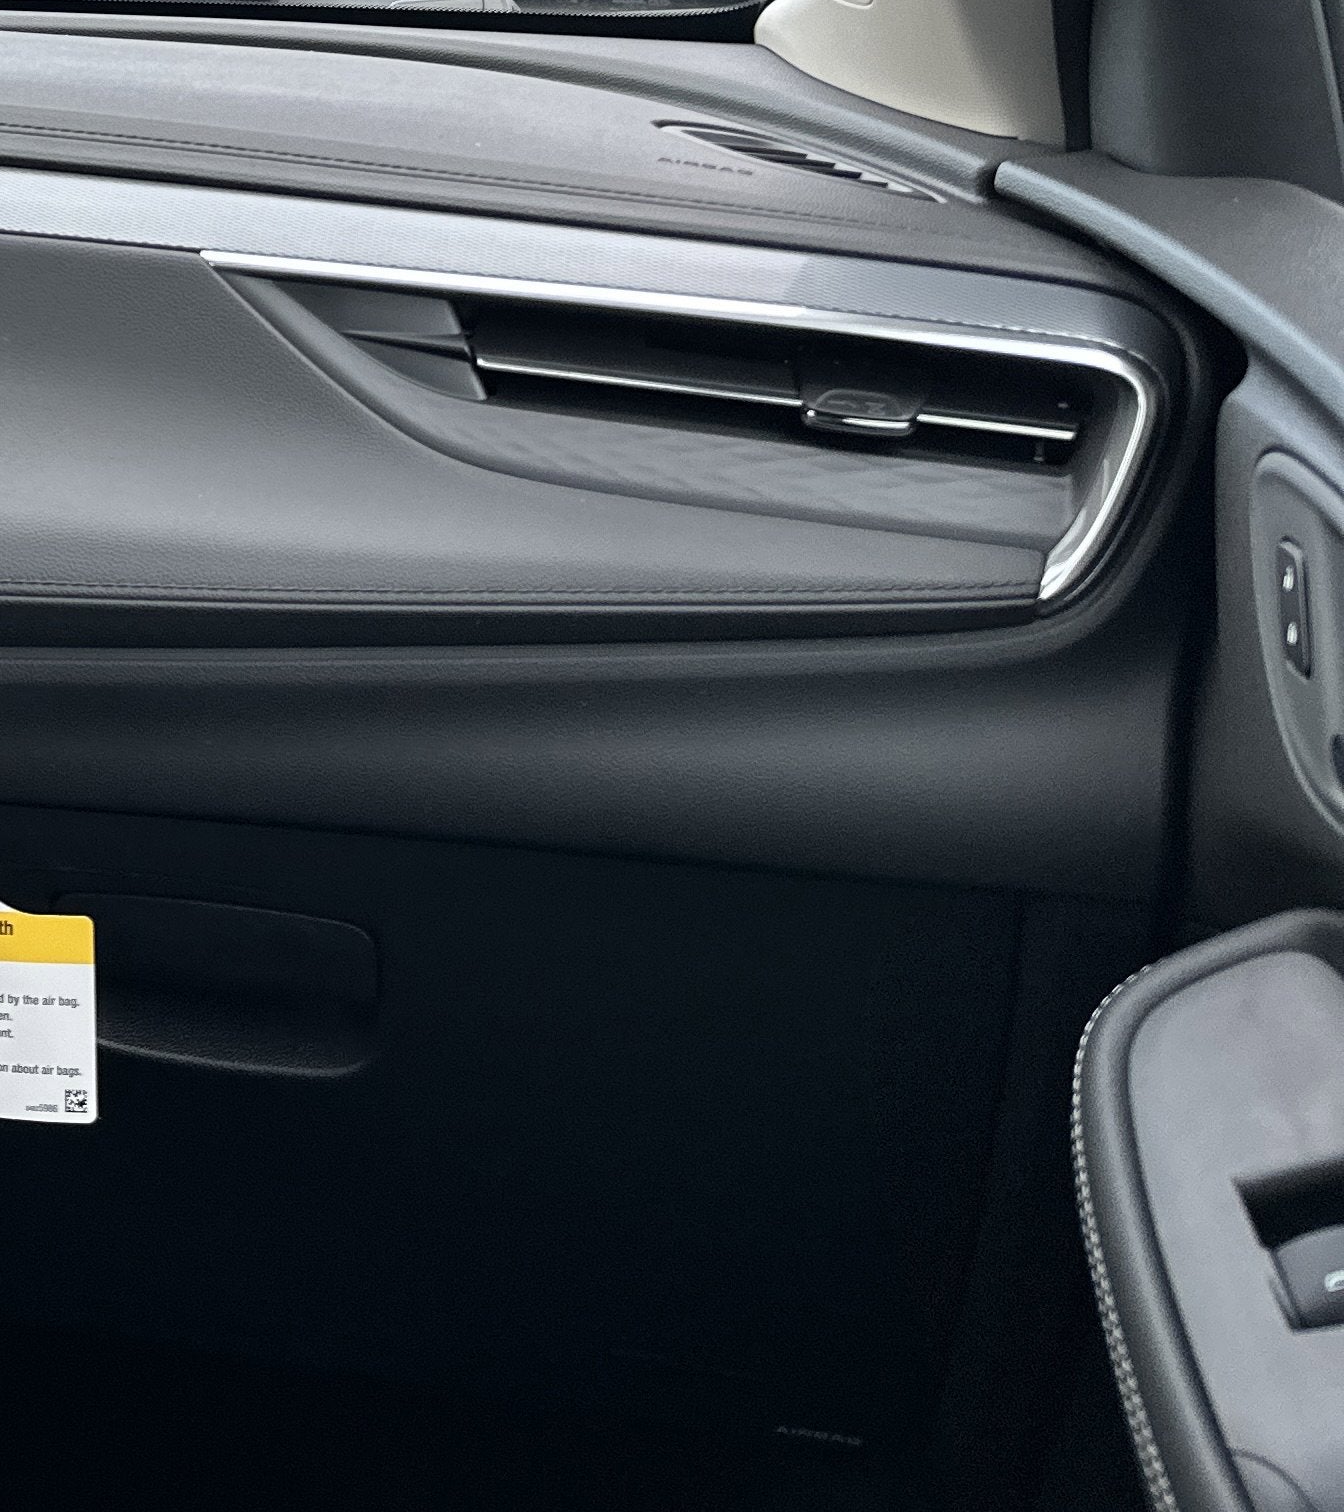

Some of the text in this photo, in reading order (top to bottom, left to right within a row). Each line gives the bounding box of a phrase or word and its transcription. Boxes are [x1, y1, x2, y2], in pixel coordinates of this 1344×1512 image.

[8, 994, 19, 1006] by
[22, 995, 39, 1005] the
[42, 996, 55, 1006] air
[58, 996, 80, 1008] bag.
[12, 1063, 39, 1074] about
[42, 1065, 54, 1075] air
[57, 1066, 82, 1078] bags.
